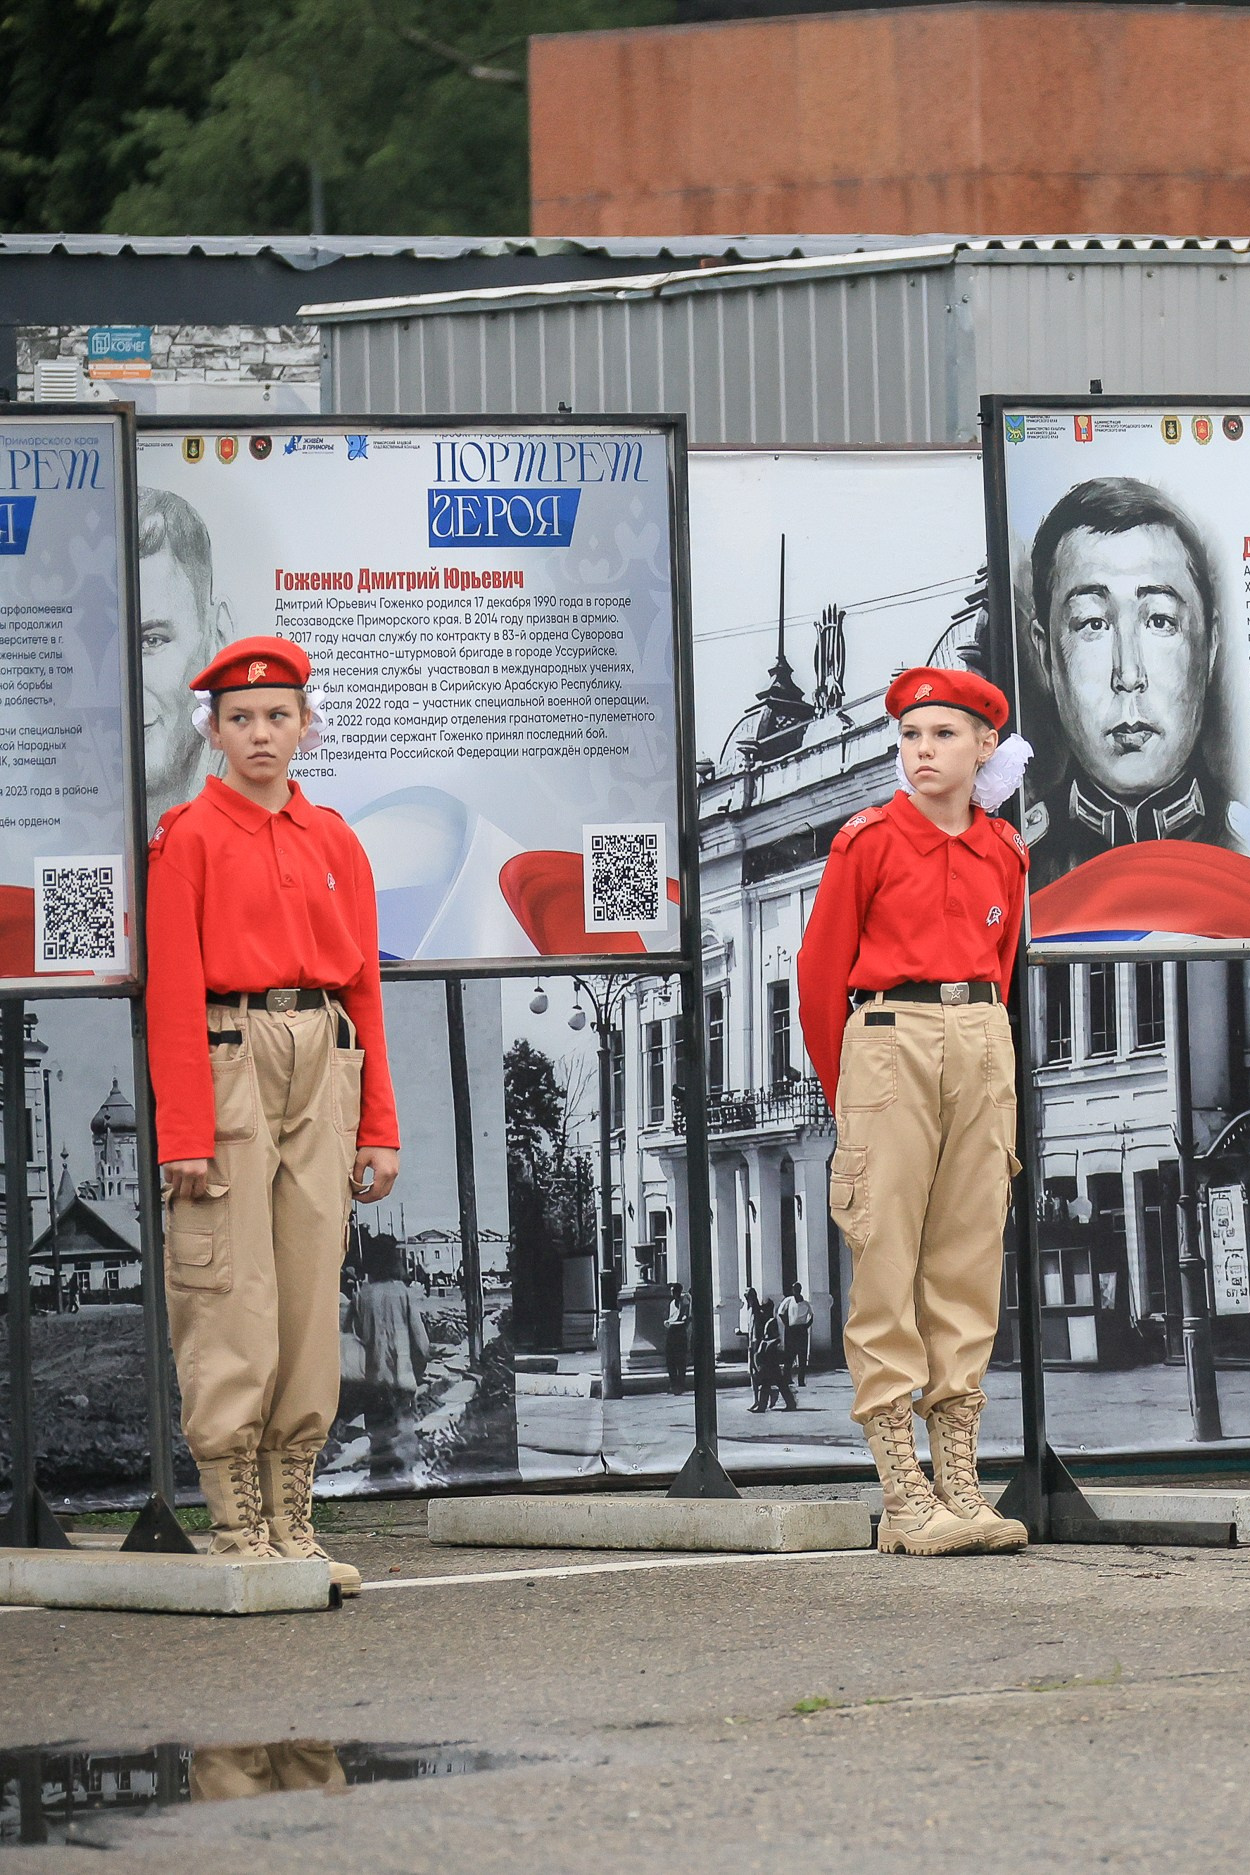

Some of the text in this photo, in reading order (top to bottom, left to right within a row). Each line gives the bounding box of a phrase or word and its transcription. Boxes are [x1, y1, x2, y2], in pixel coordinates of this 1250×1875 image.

[75, 437, 99, 447] края
[433, 441, 649, 482] ПОРТРЕТ
[432, 490, 562, 538] ГЕРОЯ
[276, 566, 524, 594] Гоженко Дмитрий Юрьевич
[275, 596, 631, 612] Дмитрий Юрьевич Гоженко родился 17 декабря 1990 года в городе
[0, 605, 73, 617] арфоломеевка
[9, 621, 63, 632] продолжил
[276, 612, 619, 628] Лесозаводске Приморского края. В 2014 году призван в армию.
[289, 628, 624, 646] 2017 году начал службу по контракту в 83-й ордена Суворова
[38, 651, 63, 660] силы
[336, 647, 456, 661] десантно-штурмовой
[459, 646, 504, 660] бригаде
[506, 649, 512, 657] в
[515, 648, 552, 660] городе
[555, 645, 617, 659] Уссурийске.
[0, 667, 46, 677] онтракту,
[17, 679, 53, 692] борьбы
[324, 678, 622, 695] был командирован в Сирийскую Арабскую Республику.
[337, 713, 655, 728] 2022 года командир отделения гранатометно-пулеметного
[18, 725, 82, 737] специальной
[17, 740, 66, 753] Народных
[13, 757, 56, 767] замещал
[289, 768, 337, 779] ужества.
[6, 785, 28, 797] 2023
[30, 788, 52, 797] года
[55, 787, 60, 796] в
[62, 785, 99, 797] районе
[18, 818, 60, 829] орденом
